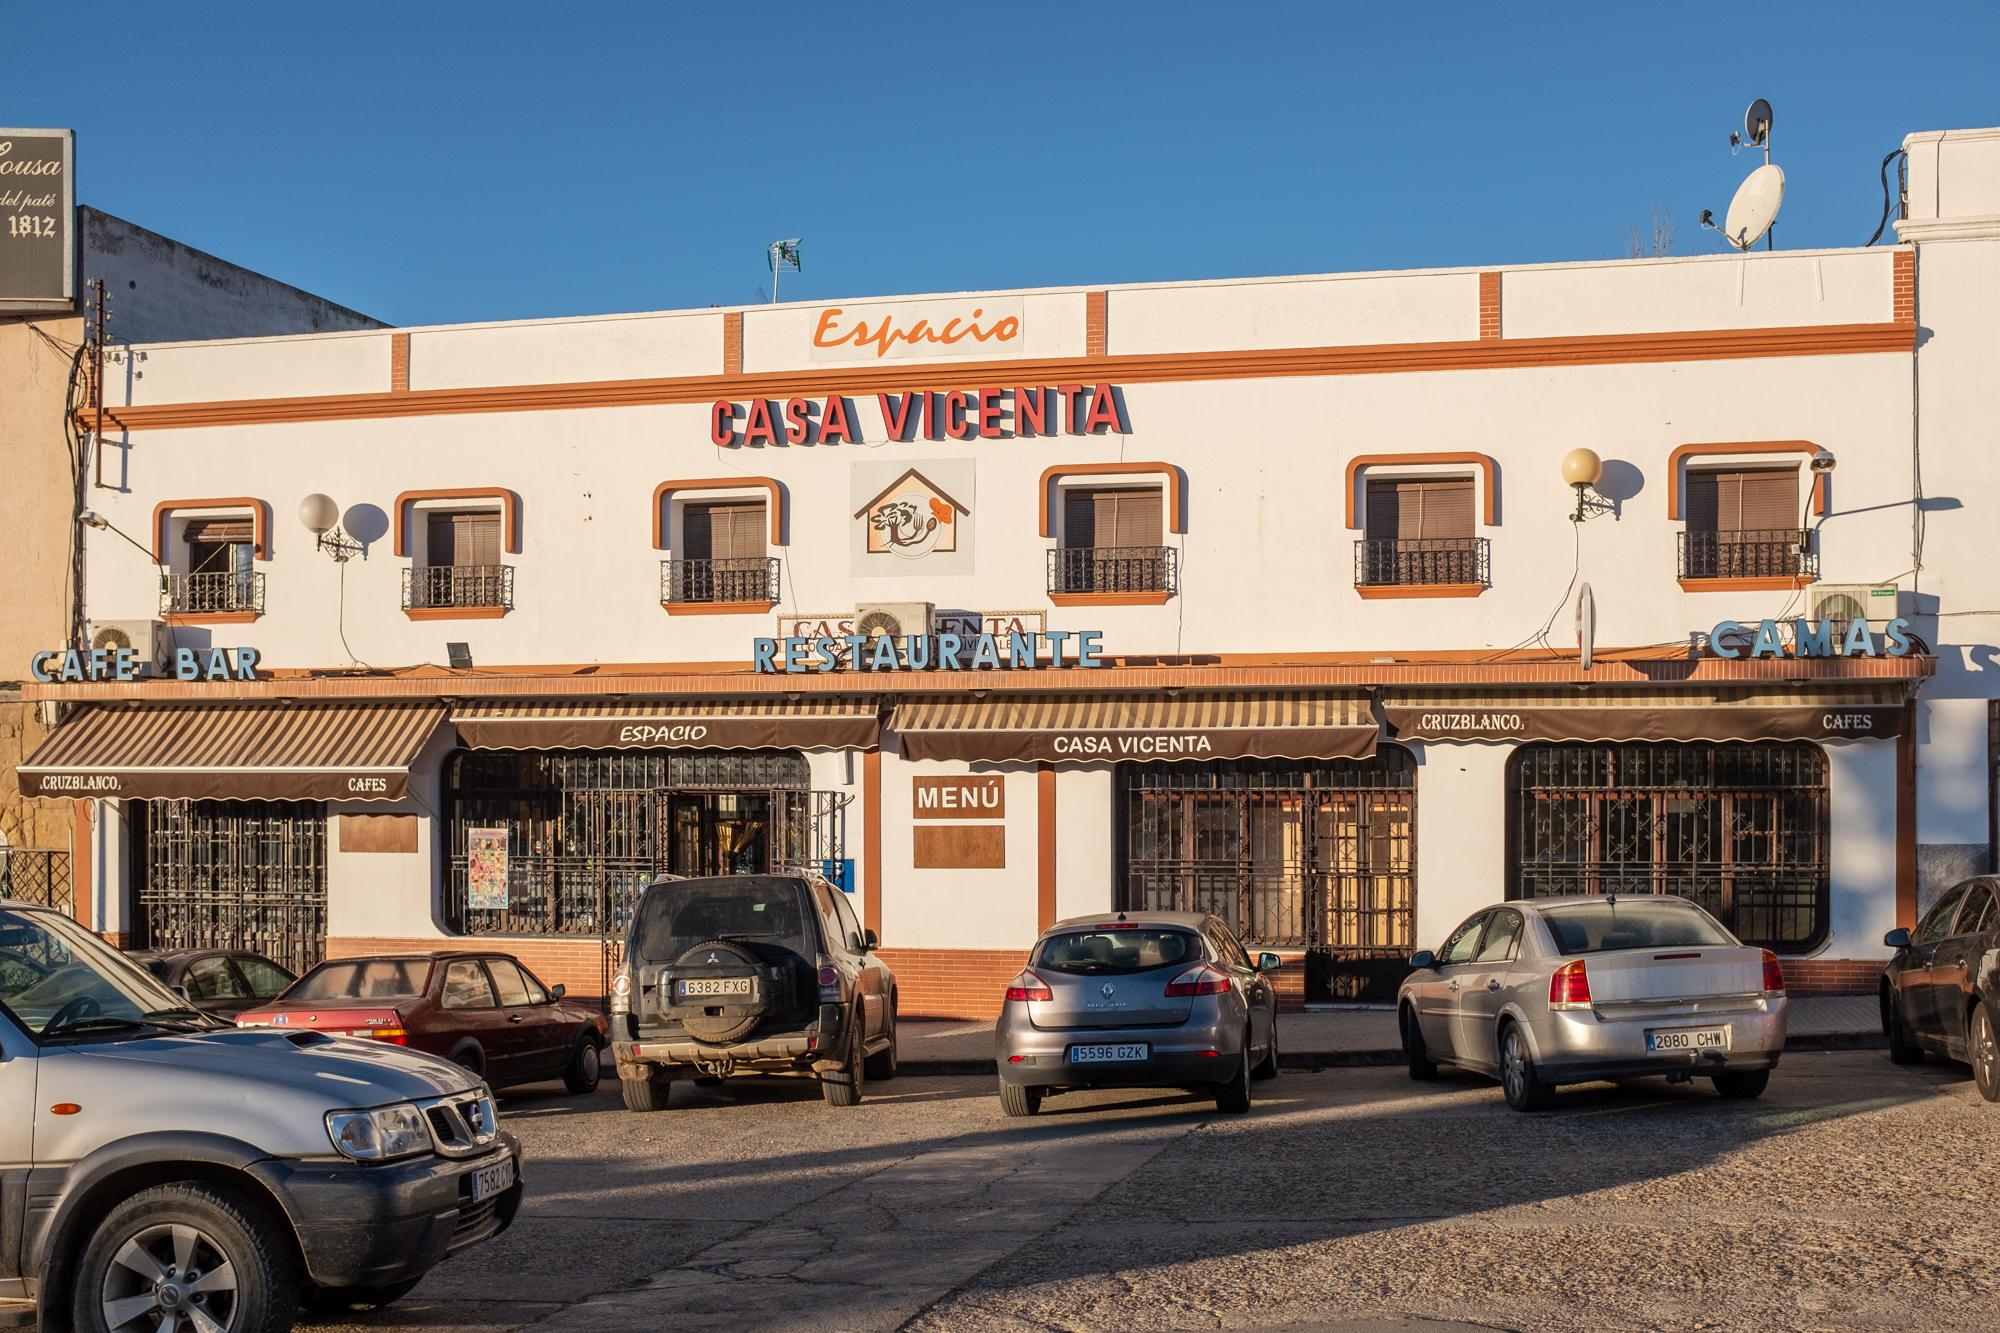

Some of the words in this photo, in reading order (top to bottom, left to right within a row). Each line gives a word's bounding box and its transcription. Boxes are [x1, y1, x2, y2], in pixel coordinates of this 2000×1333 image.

[0, 141, 62, 176] ousa
[18, 192, 56, 212] paté
[8, 215, 56, 238] 1812
[813, 308, 1019, 358] Espacio
[711, 394, 854, 447] CASA
[877, 383, 1123, 443] VICENTA
[793, 620, 855, 640] CAS
[1711, 617, 1910, 658] CAMAS
[754, 630, 1103, 673] RESTAURANTE
[32, 648, 138, 682] CAFE
[177, 647, 258, 681] BAR
[1422, 713, 1520, 730] CRUZBLANCO
[1822, 714, 1873, 730] CAFES
[620, 725, 707, 742] ESPACIO
[1053, 736, 1112, 753] CASA
[1118, 735, 1212, 753] VICENTA
[42, 775, 118, 790] CRUZBLANCO
[348, 777, 387, 791] CAFES
[917, 780, 1000, 808] MENÚ
[688, 981, 720, 994] 6382
[723, 980, 748, 993] FXG
[1655, 1034, 1689, 1048] 2080
[1696, 1032, 1721, 1046] CHW
[1080, 1046, 1113, 1059] 5596
[1117, 1046, 1142, 1058] GZK
[479, 1167, 500, 1197] 7582
